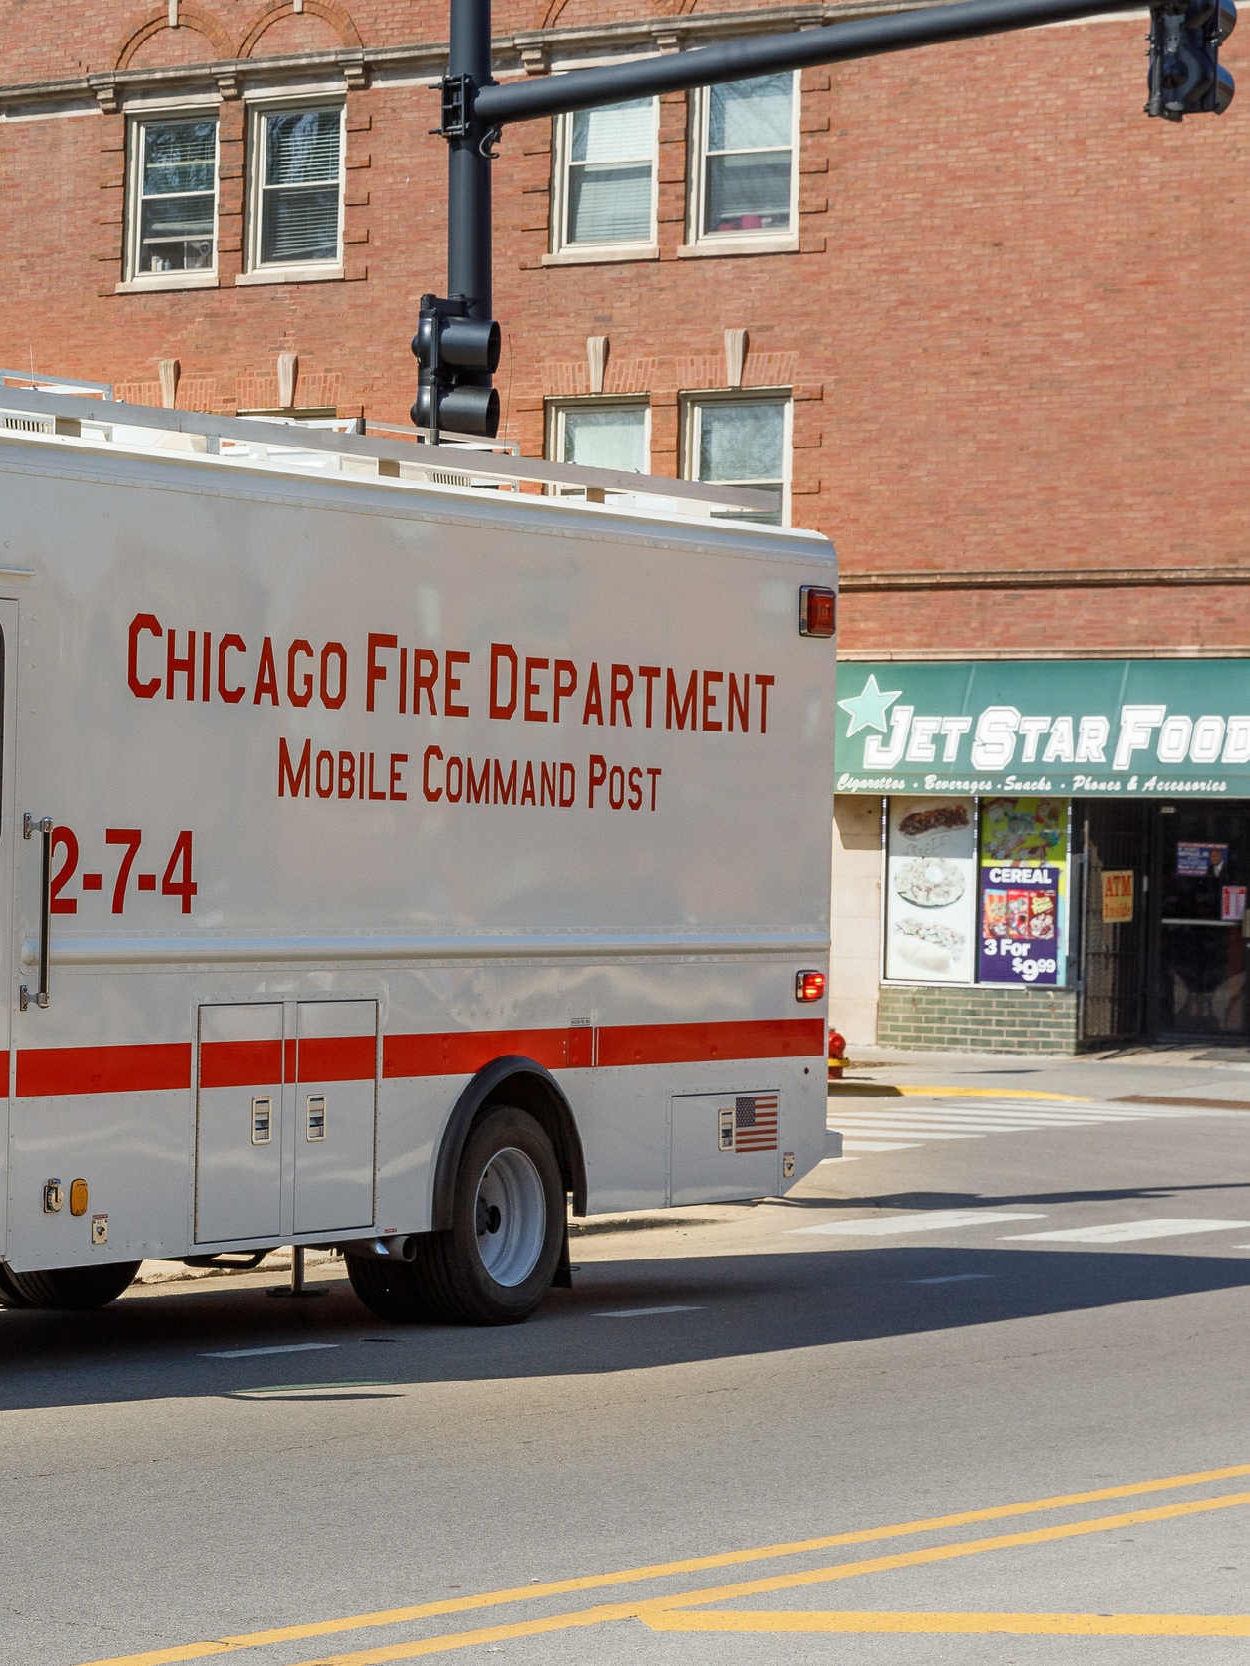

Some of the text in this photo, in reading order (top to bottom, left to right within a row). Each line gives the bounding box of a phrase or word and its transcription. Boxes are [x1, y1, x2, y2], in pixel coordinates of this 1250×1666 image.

[127, 612, 776, 734] CHICAGO FIRE DEPARTMENT
[862, 705, 973, 770] JET
[970, 705, 1110, 771] STAR
[277, 737, 662, 812] MOBILE COMMAND POST
[836, 772, 1228, 794] Cigarettes Beverages Snacks Phones & Accessories
[50, 825, 198, 915] 2-7-4
[988, 867, 1052, 885] CEREAL
[1105, 874, 1132, 898] ATM
[983, 938, 1031, 957] 3 For
